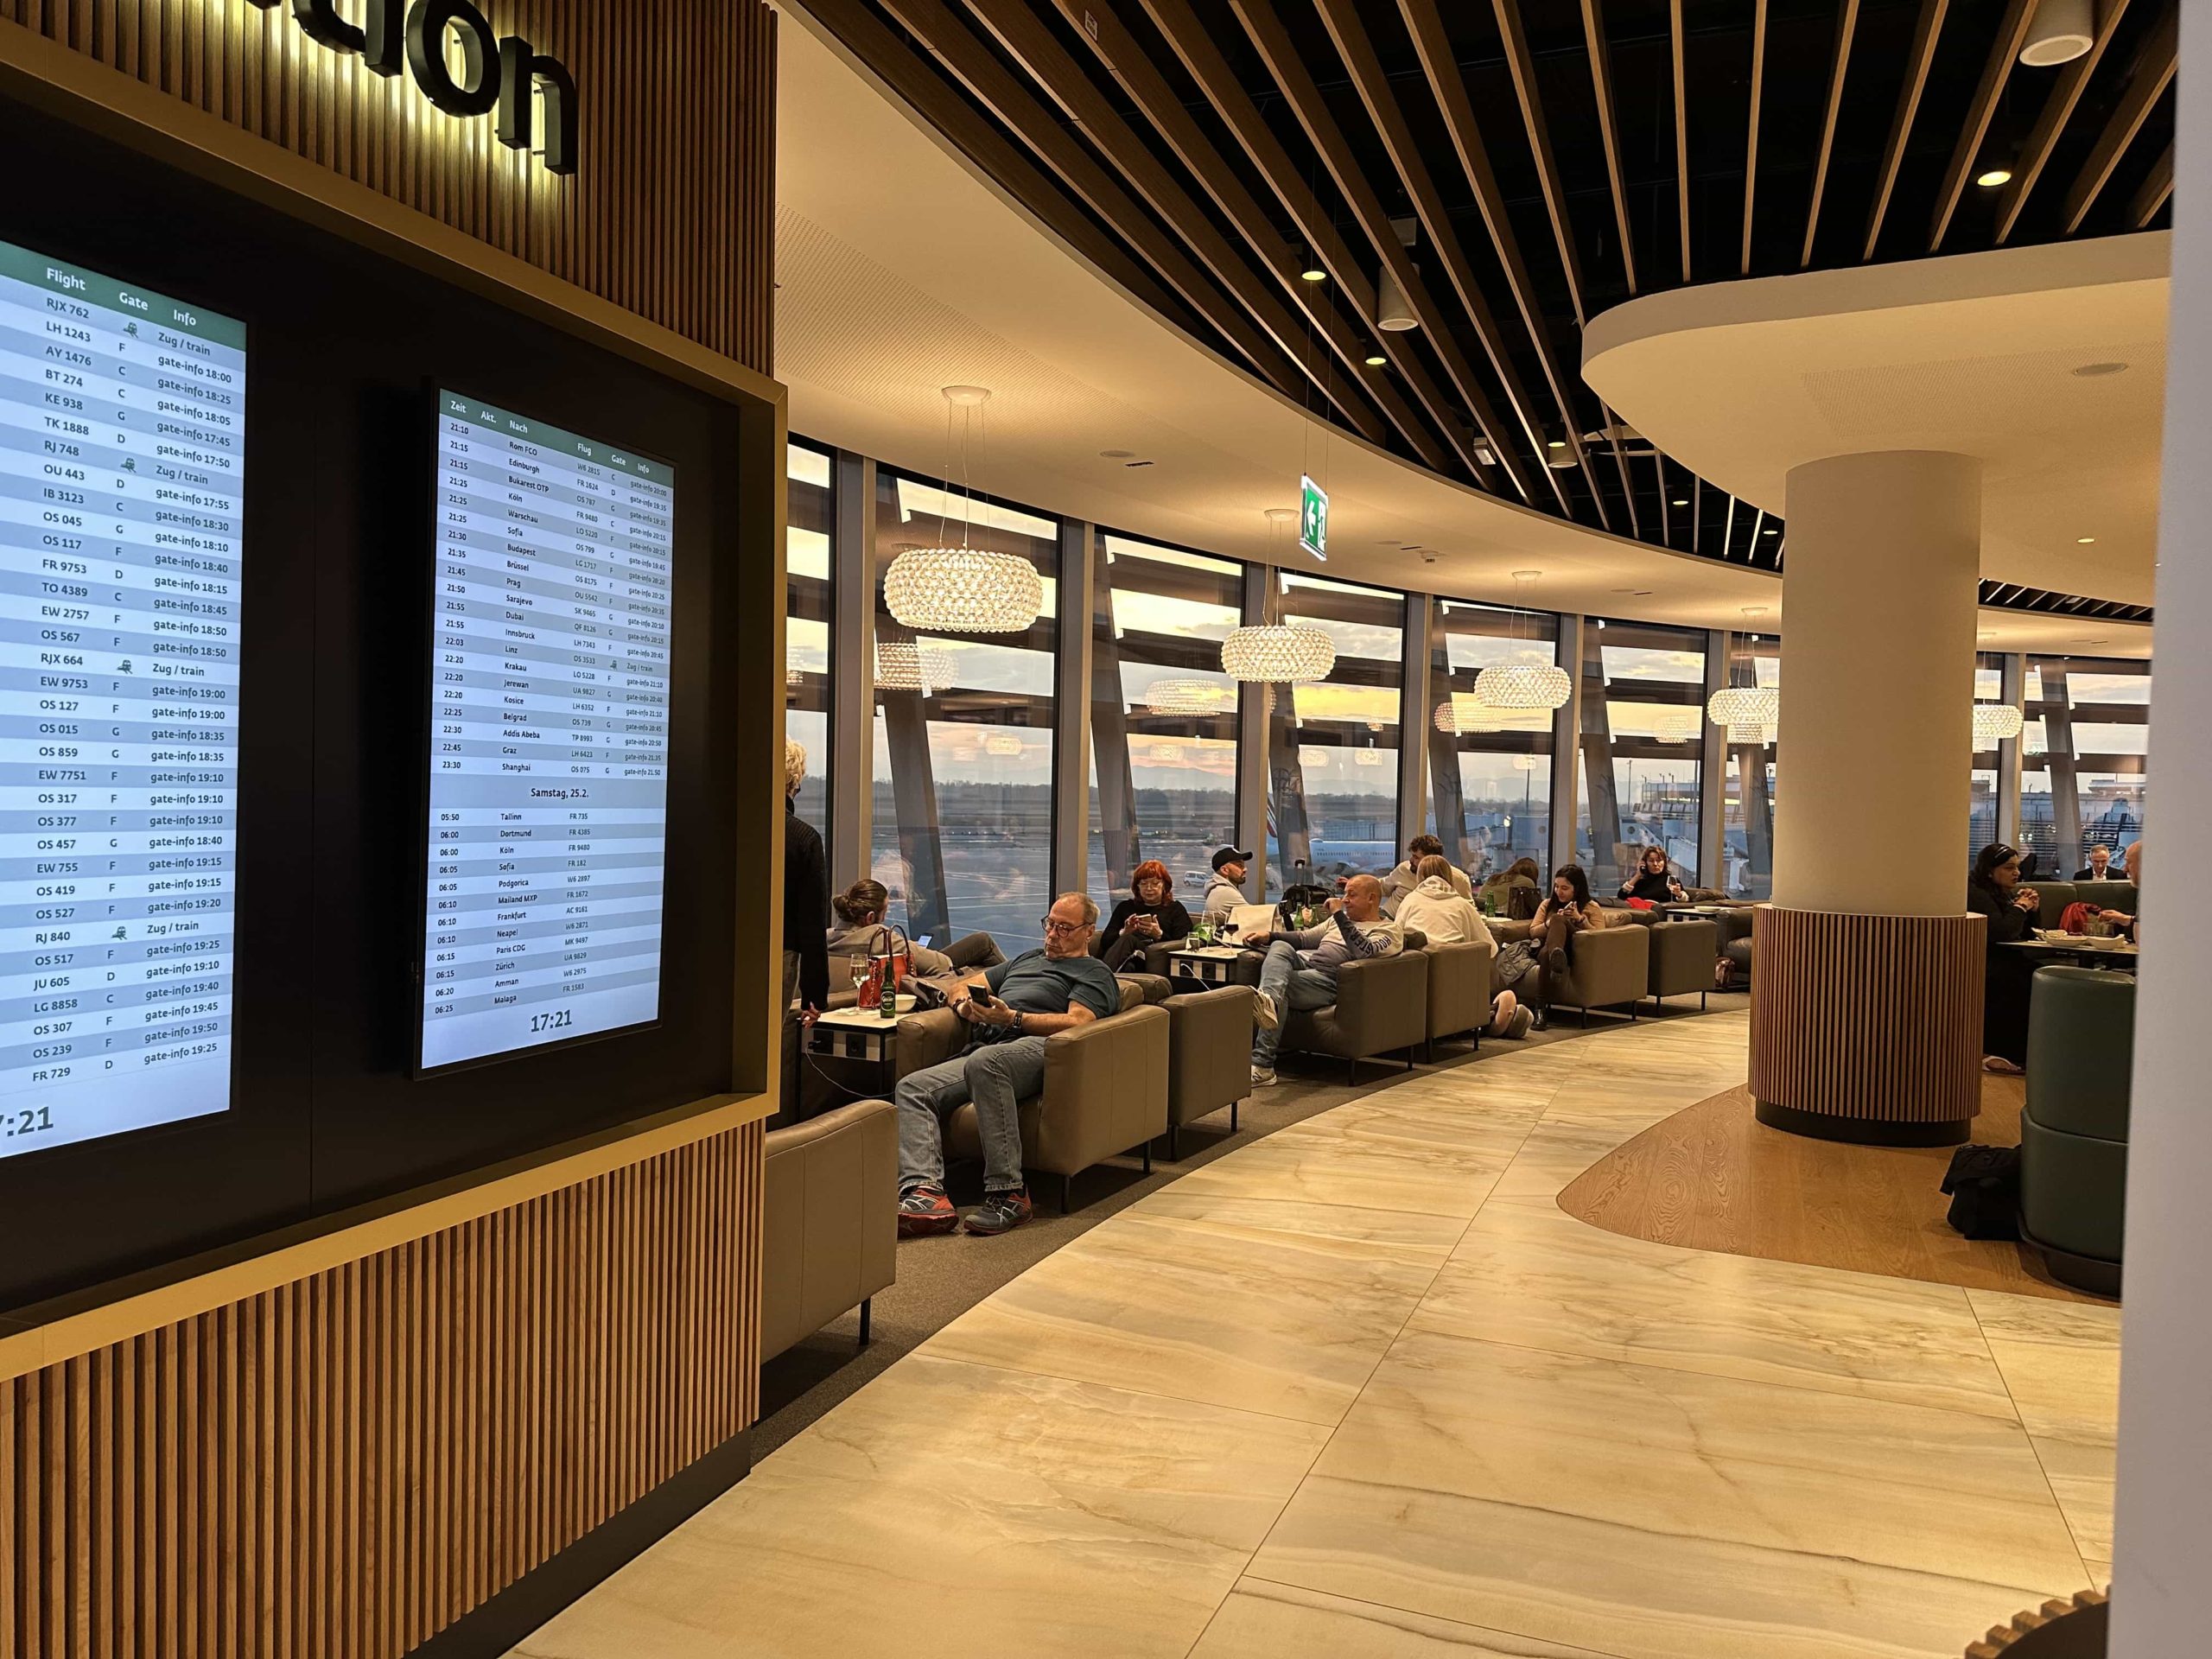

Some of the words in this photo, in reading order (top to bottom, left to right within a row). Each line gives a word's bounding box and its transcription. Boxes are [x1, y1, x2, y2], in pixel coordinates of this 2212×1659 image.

[47, 267, 86, 290] Flight
[118, 291, 148, 310] Gate
[173, 308, 196, 326] Info
[47, 297, 67, 312] RJX
[69, 303, 88, 319] 762
[158, 332, 177, 348] Zug
[180, 339, 184, 348] /
[186, 340, 210, 356] train
[46, 321, 61, 334] LH
[64, 327, 91, 342] 1243
[118, 342, 125, 352] F
[158, 356, 204, 376] gate-info
[206, 368, 232, 383] 18:00
[45, 392, 60, 405] KE
[62, 397, 83, 410] 938
[118, 411, 124, 421] G
[156, 423, 203, 441] gate-info
[204, 433, 230, 447] 17:45
[449, 400, 466, 413] Zeit
[480, 410, 498, 423] Akt.
[509, 419, 527, 434] Nach
[577, 442, 591, 456] Flug
[611, 454, 626, 466] Gate
[637, 462, 649, 474] Info
[450, 422, 468, 435] 21:10
[509, 441, 524, 452] Rom
[524, 445, 537, 456] FCO
[450, 440, 468, 452] 21:15
[508, 457, 539, 474] Edinburgh
[449, 458, 467, 470] 21:15
[508, 475, 536, 489] Bukarest
[536, 483, 549, 493] OTP
[43, 464, 62, 476] OU
[65, 468, 85, 480] 443
[116, 478, 124, 488] D
[156, 489, 201, 505] gate-info
[203, 497, 229, 510] 17:55
[449, 476, 467, 487] 21:25
[508, 492, 522, 503] Köln
[448, 493, 467, 505] 21:25
[507, 509, 537, 523] Warschau
[448, 512, 467, 523] 21:25
[507, 526, 523, 537] Sofia
[448, 530, 467, 541] 21:30
[506, 543, 536, 556] Budapest
[42, 535, 59, 546] OS
[61, 537, 81, 550] 117
[115, 546, 121, 556] F
[155, 555, 200, 569] gate-info
[202, 561, 228, 573] 18:40
[448, 547, 466, 558] 21:35
[506, 560, 529, 571] Brüssel
[447, 565, 466, 576] 21:45
[506, 577, 520, 588] Prag
[41, 582, 59, 593] TO
[60, 585, 87, 596] 4389
[114, 592, 122, 601] C
[154, 599, 200, 613] gate-info
[201, 604, 226, 615] 18:45
[446, 583, 465, 594] 21:50
[505, 594, 532, 606] Sarajevo
[41, 605, 60, 617] EW
[62, 607, 89, 620] 2757
[114, 614, 120, 623] F
[153, 620, 199, 634] gate-info
[200, 625, 226, 636] 18:50
[446, 601, 465, 611] 21:55
[505, 611, 524, 620] Dubai
[446, 619, 464, 629] 21:55
[505, 628, 535, 639] Innsbruck
[445, 636, 463, 646] 22:03
[505, 645, 518, 653] Linz
[445, 654, 463, 664] 22:20
[505, 662, 527, 671] Krakau
[40, 676, 60, 687] EW
[61, 677, 88, 689] 9753
[112, 682, 119, 690] F
[152, 685, 198, 698] gate-info
[200, 689, 226, 698] 19:00
[444, 672, 463, 682] 22:20
[503, 678, 529, 689] Jerewan
[443, 690, 462, 699] 22:20
[504, 696, 524, 704] Kosice
[443, 708, 462, 716] 22:25
[503, 712, 527, 722] Belgrad
[443, 725, 462, 734] 22:30
[502, 728, 520, 737] Addis
[520, 730, 540, 739] Abeba
[39, 747, 55, 756] OS
[57, 747, 78, 757] 859
[111, 749, 119, 758] G
[150, 750, 196, 762] gate-info
[198, 752, 224, 761] 18:35
[442, 743, 461, 752] 22:45
[442, 760, 461, 769] 23:30
[501, 763, 531, 772] Shanghai
[531, 787, 569, 799] Samstag,
[569, 788, 588, 798] 25.2.
[37, 817, 54, 826] OS
[56, 817, 76, 826] 377
[110, 816, 117, 825] F
[149, 815, 195, 827] gate-info
[197, 815, 223, 824] 19:10
[440, 830, 459, 839] 06:00
[499, 829, 531, 837] Dortmund
[439, 848, 459, 856] 06:00
[36, 863, 55, 873] EW
[58, 862, 78, 872] 755
[109, 861, 116, 870] F
[149, 857, 194, 871] gate-info
[195, 857, 221, 867] 19:15
[439, 865, 458, 874] 06:05
[499, 862, 514, 872] Sofia
[438, 883, 457, 892] 06:05
[498, 878, 529, 888] Podgorica
[438, 900, 456, 909] 06:10
[498, 894, 523, 904] Mailand
[523, 893, 537, 902] MXP
[437, 917, 456, 926] 06:10
[497, 911, 526, 920] Frankfurt
[436, 935, 455, 944] 06:10
[497, 928, 518, 938] Neapel
[436, 952, 455, 962] 06:15
[496, 944, 512, 954] Paris
[512, 944, 525, 952] CDG
[33, 978, 47, 991] JU
[49, 976, 70, 988] 605
[106, 971, 115, 981] D
[146, 963, 192, 979] gate-info
[194, 960, 219, 971] 19:10
[435, 969, 454, 979] 06:15
[495, 961, 515, 970] Zürich
[435, 987, 454, 997] 06:20
[494, 978, 518, 988] Amman
[435, 1004, 453, 1014] 06:25
[493, 995, 517, 1004] Malaga
[531, 1008, 572, 1033] 17:21
[32, 1071, 48, 1082] FR
[50, 1066, 70, 1078] 729
[105, 1059, 113, 1069] D
[143, 1046, 189, 1065] gate-info
[191, 1042, 217, 1055] 19:25
[0, 1106, 54, 1136] :21
